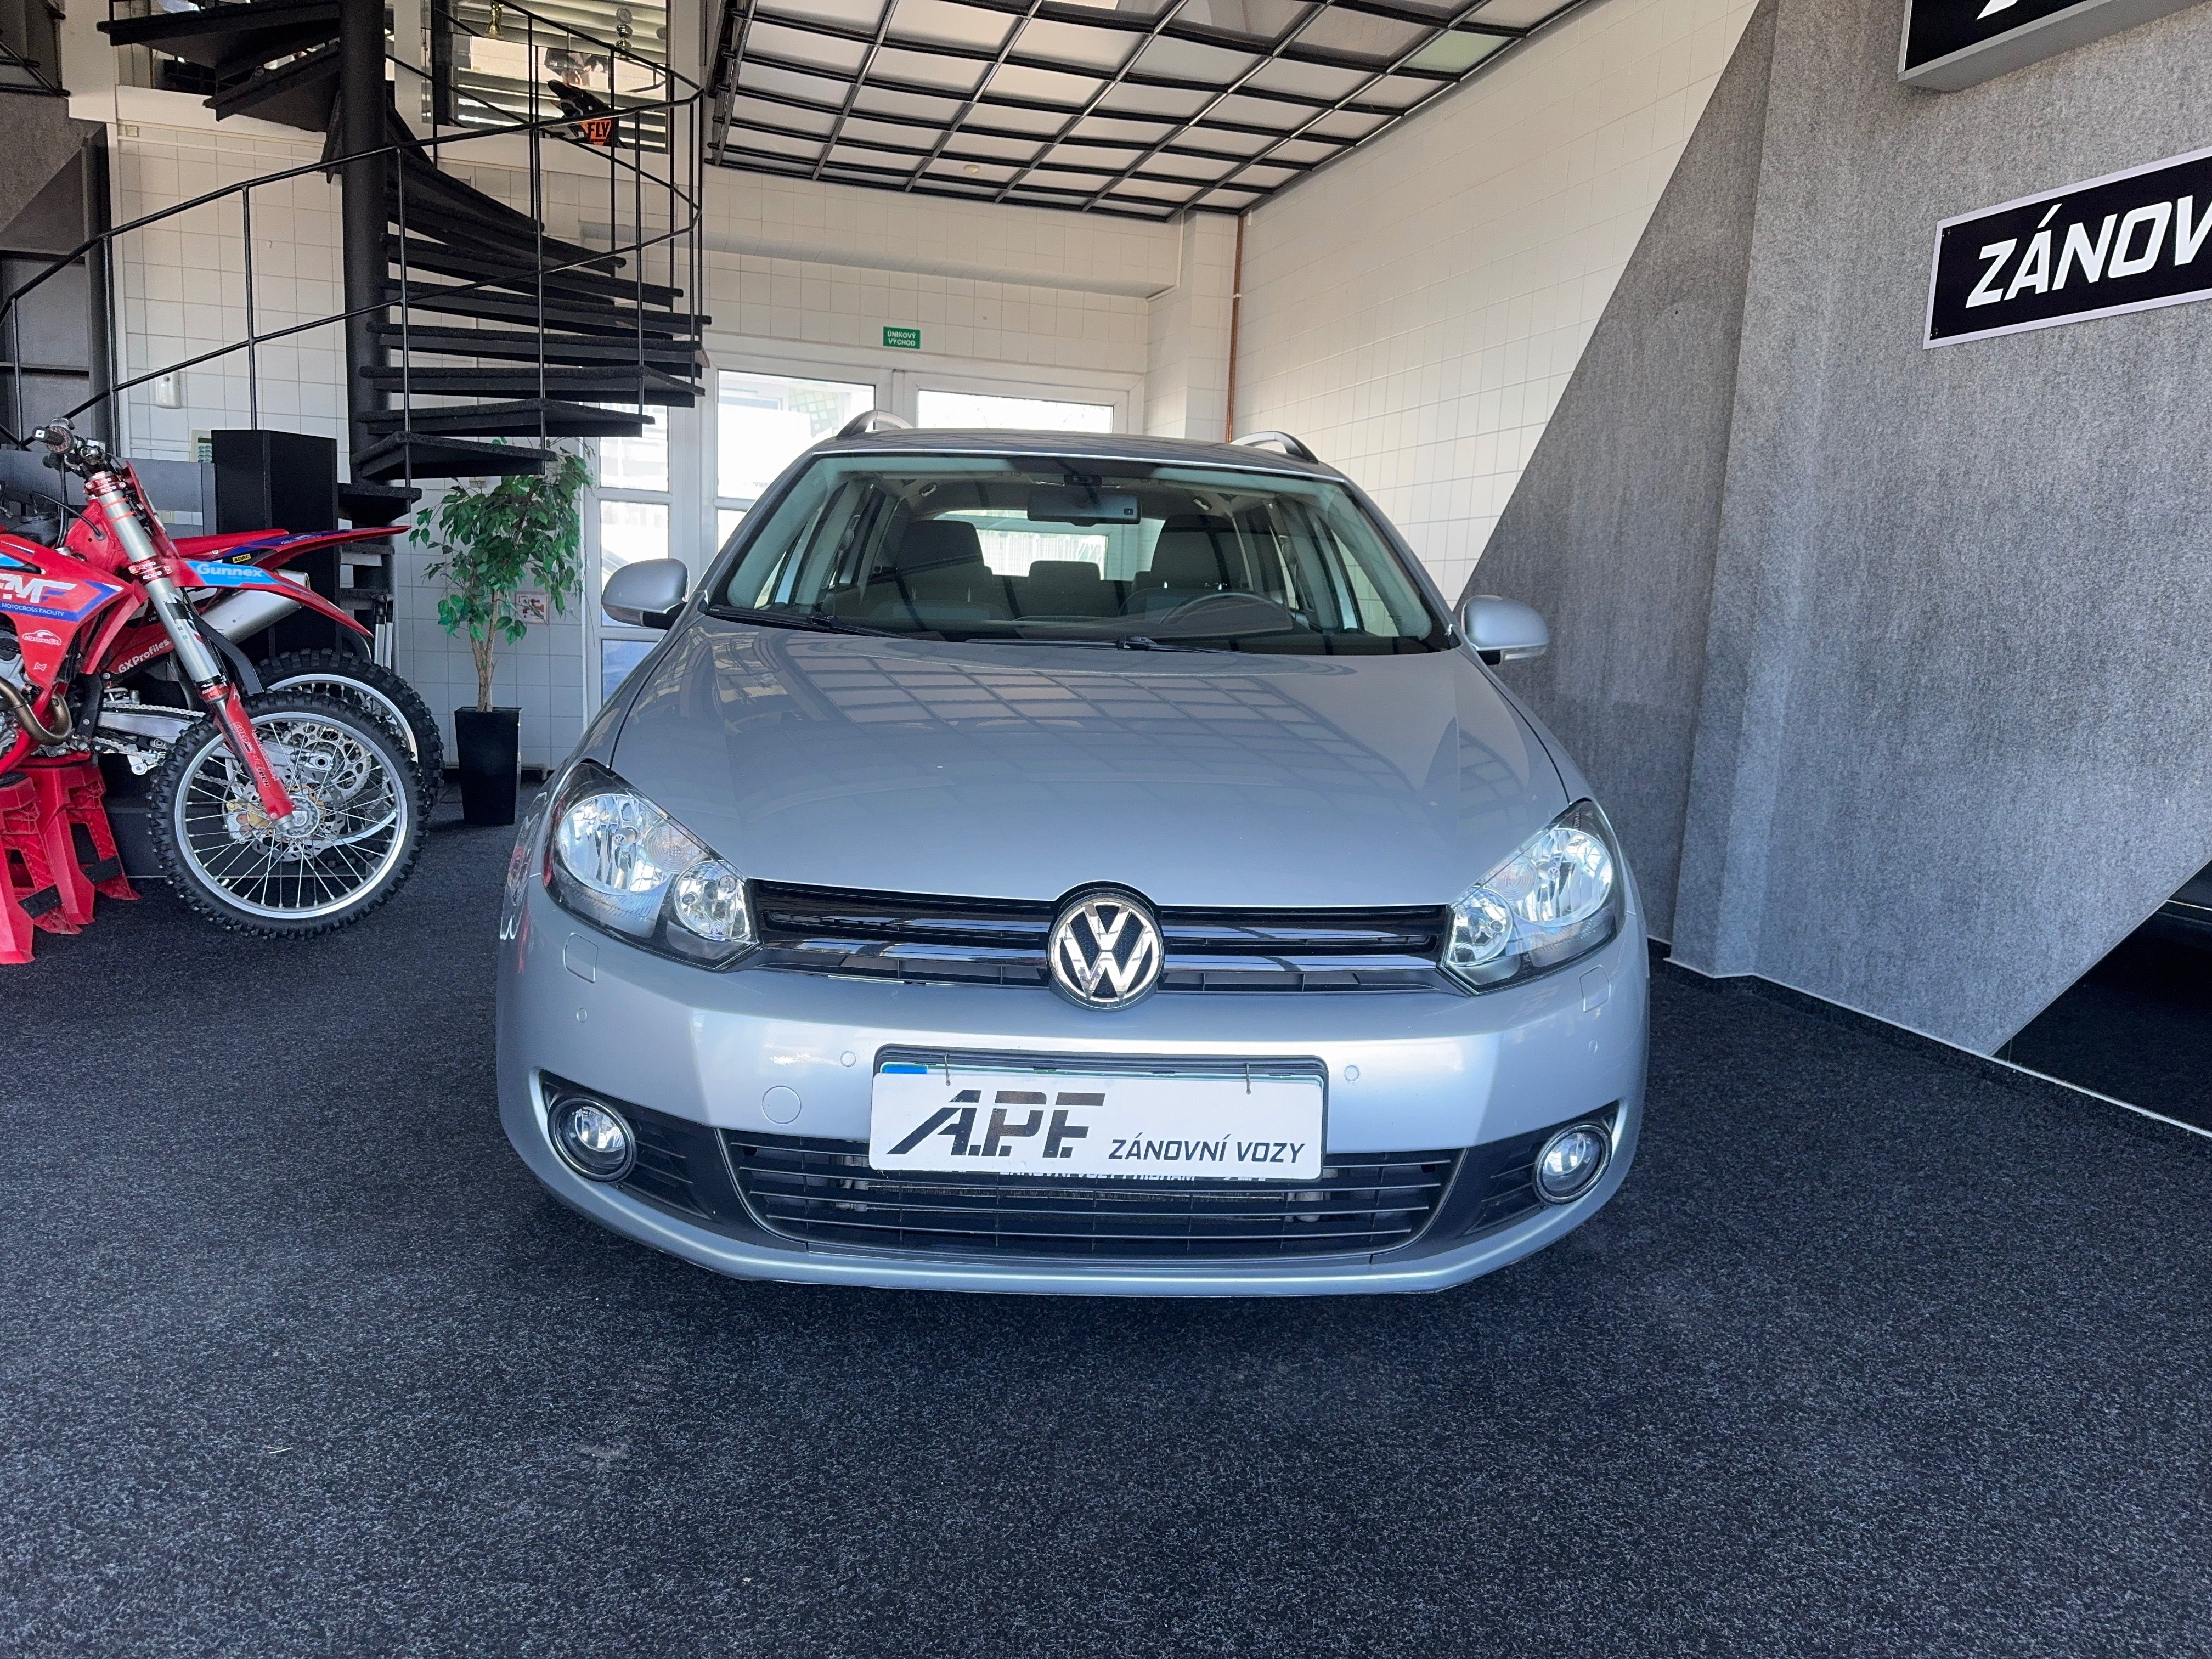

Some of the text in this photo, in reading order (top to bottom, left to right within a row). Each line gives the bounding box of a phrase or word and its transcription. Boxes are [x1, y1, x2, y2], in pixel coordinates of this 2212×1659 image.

[587, 122, 610, 138] FLY
[887, 329, 916, 339] ÚNIKOVÝ
[888, 337, 916, 346] VÝCHOD
[234, 554, 250, 563] ADAC
[196, 563, 263, 577] Gunnex
[2, 603, 38, 612] MOTOCROSS
[1053, 898, 1159, 1005] VW
[1108, 1132, 1232, 1161] ZÁNOVNÍ
[1237, 1142, 1306, 1163] VOZY
